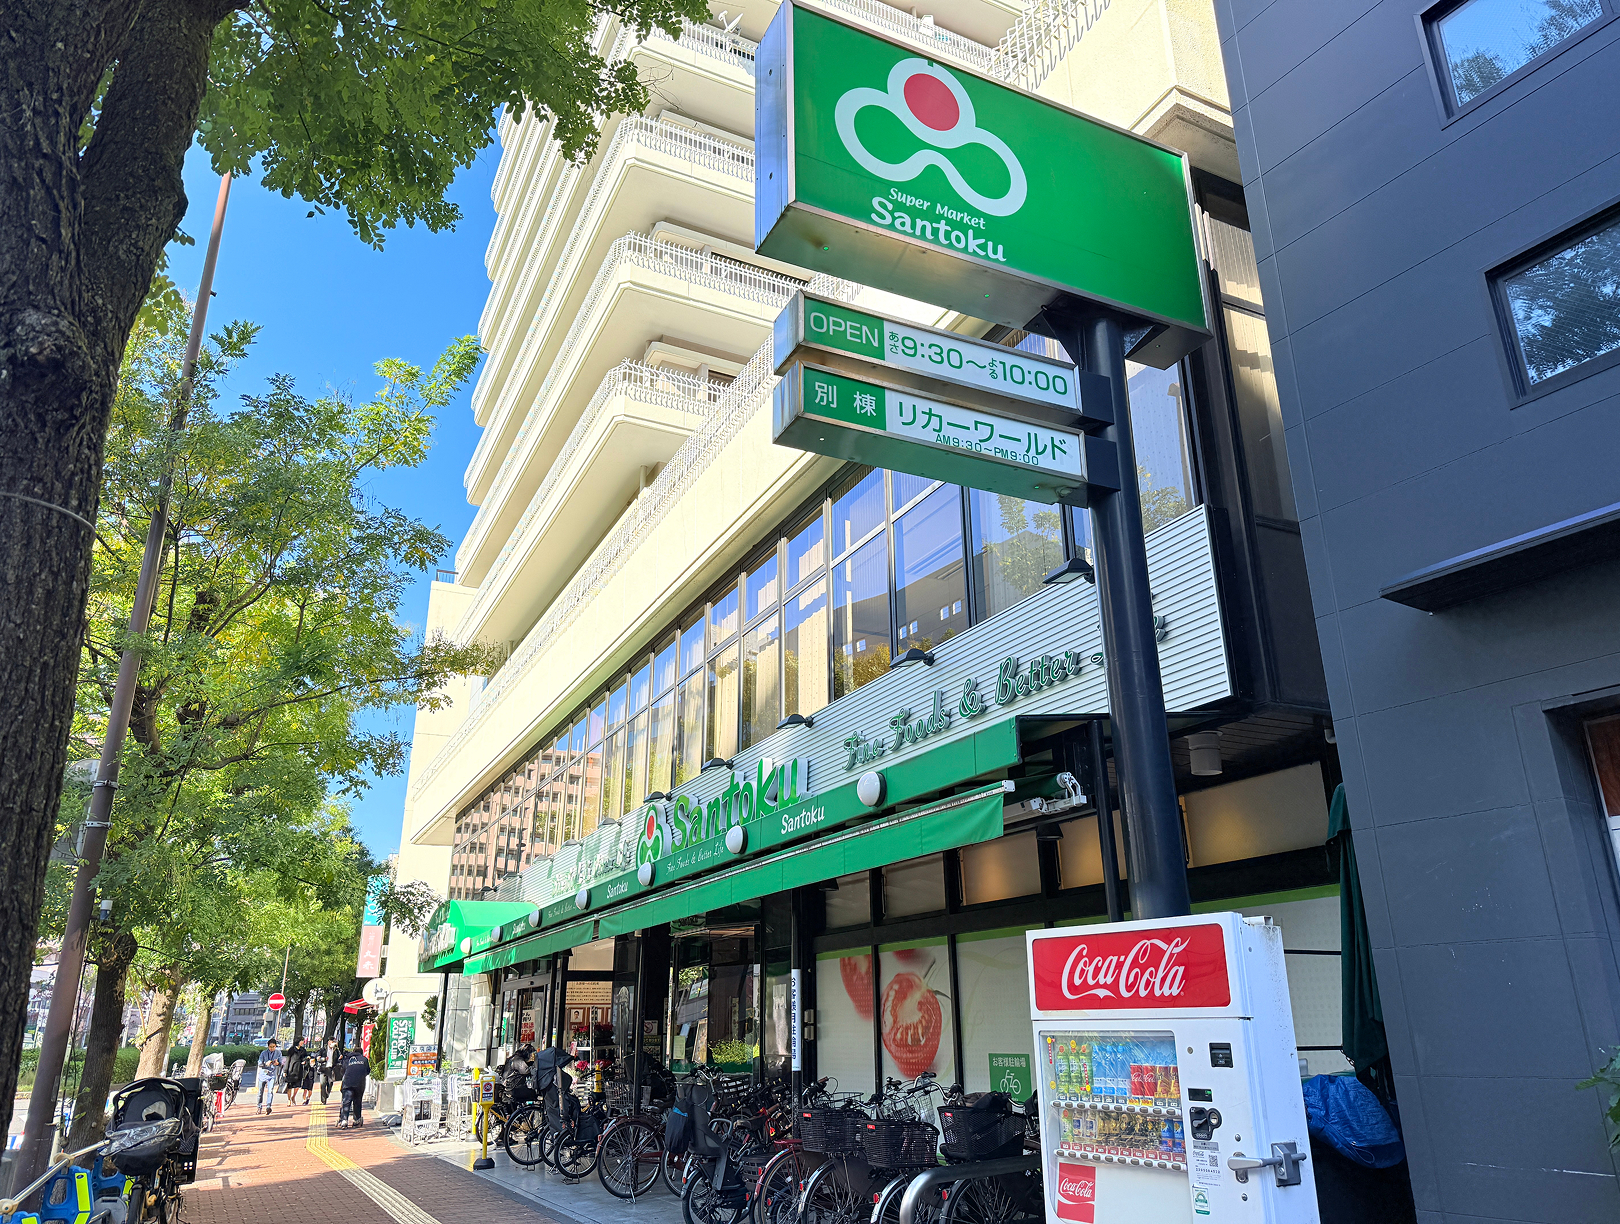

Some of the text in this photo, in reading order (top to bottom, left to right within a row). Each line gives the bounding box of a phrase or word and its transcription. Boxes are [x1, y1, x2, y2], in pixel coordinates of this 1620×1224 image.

[870, 196, 1007, 262] Santoku
[889, 187, 986, 230] Super Market
[810, 312, 879, 348] OPEN
[999, 360, 1068, 396] 10:00
[899, 401, 1068, 461] リカーワールド
[842, 648, 1081, 771] Fine Foods & Better
[671, 758, 807, 853] Santoku
[781, 805, 826, 835] Santoku
[606, 881, 629, 899] Santoku
[1061, 936, 1191, 1000] Coca-Cola
